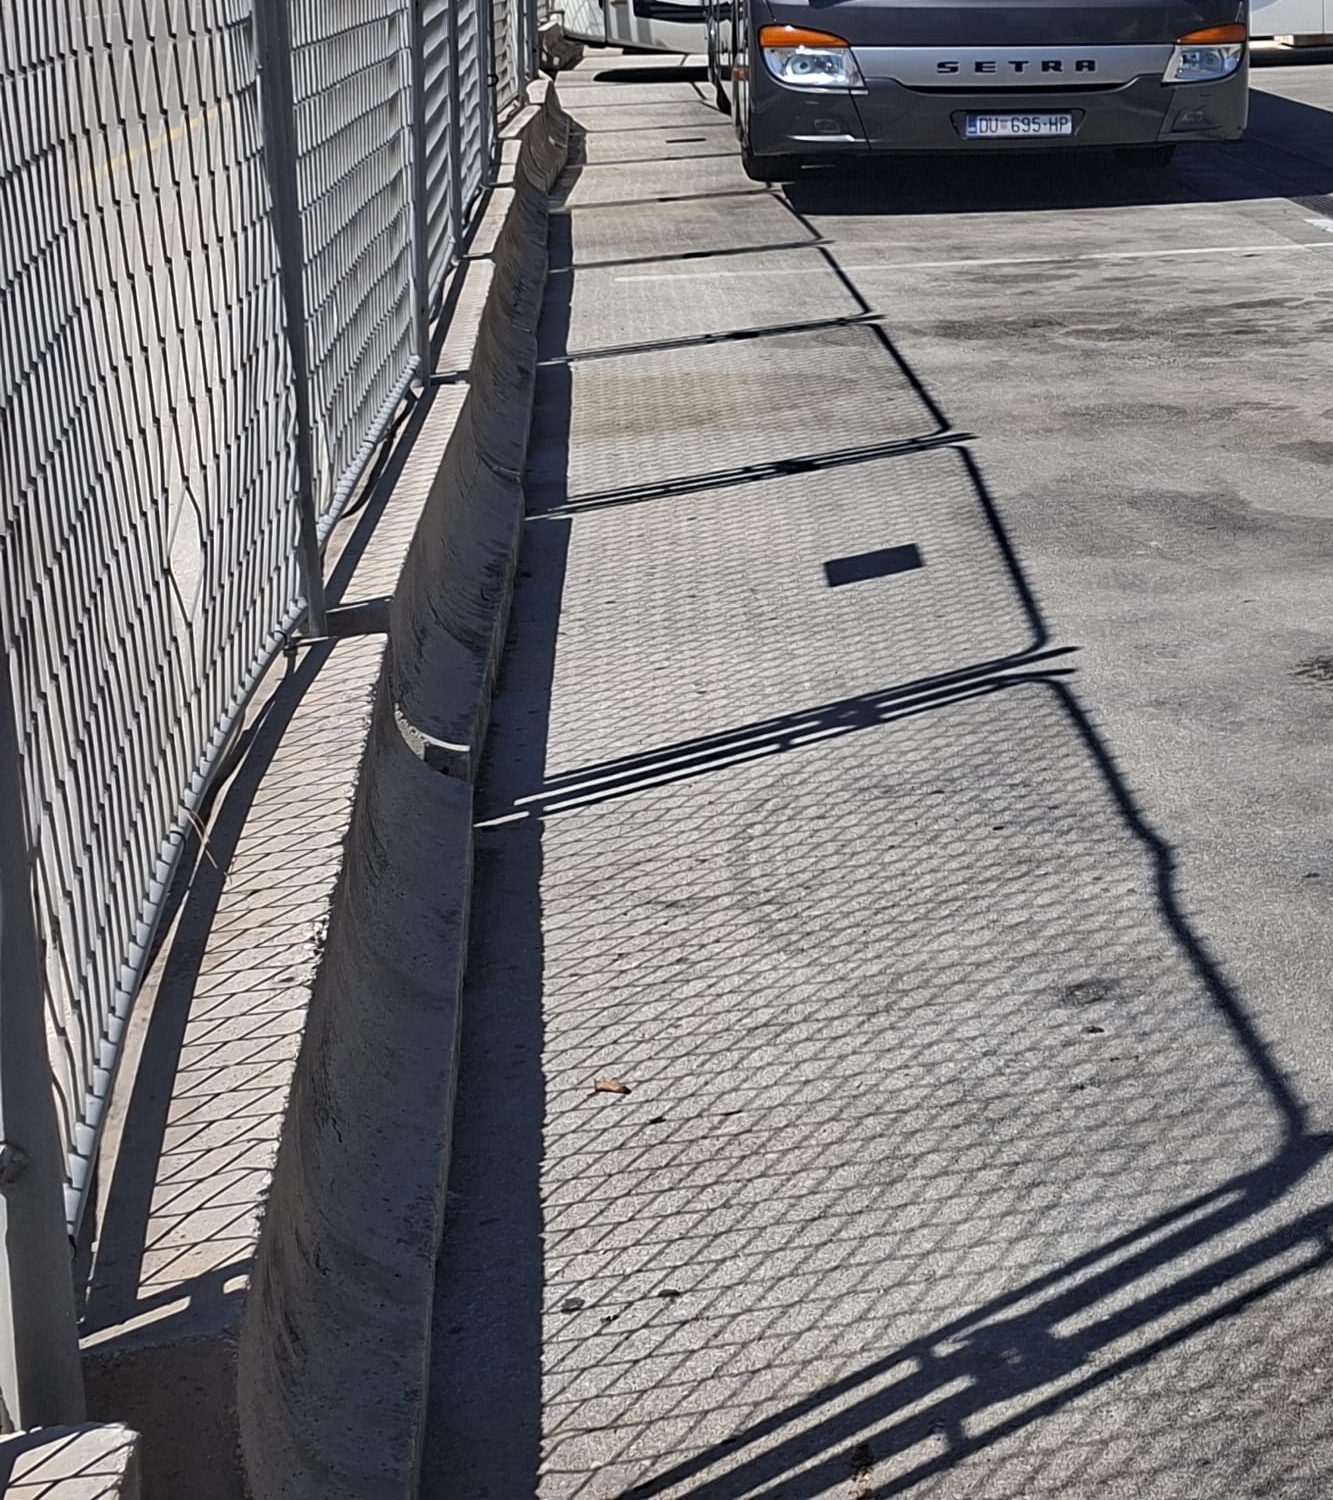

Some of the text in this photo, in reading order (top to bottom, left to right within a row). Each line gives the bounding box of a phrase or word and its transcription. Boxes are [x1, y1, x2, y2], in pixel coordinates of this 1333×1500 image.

[936, 60, 1097, 74] SETRA
[979, 116, 1069, 134] DU 695-HP
